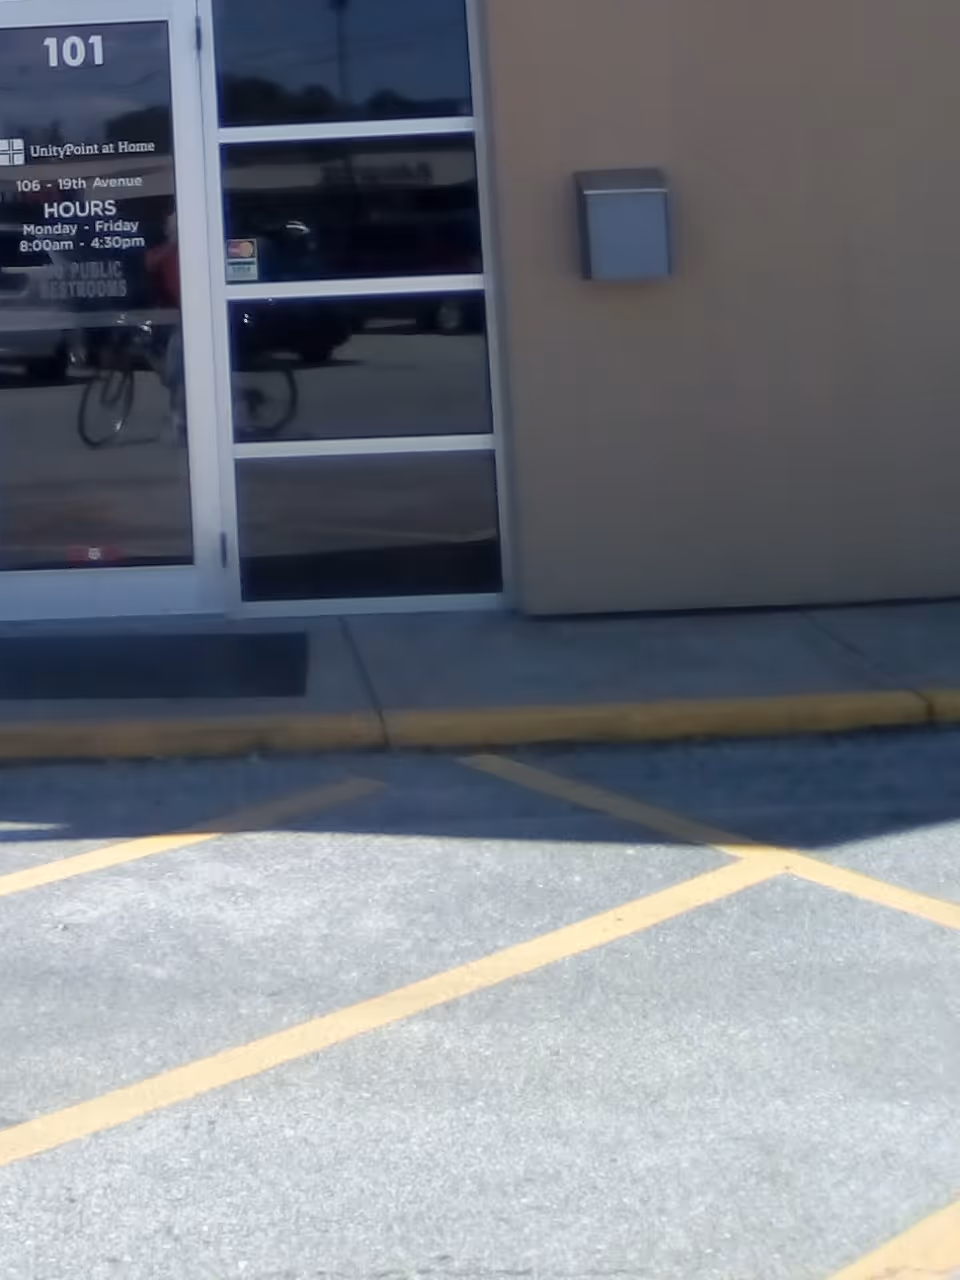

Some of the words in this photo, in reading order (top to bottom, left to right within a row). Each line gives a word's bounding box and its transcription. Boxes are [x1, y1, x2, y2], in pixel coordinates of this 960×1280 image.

[43, 34, 105, 67] 101
[29, 142, 99, 159] UnityPoint
[101, 142, 115, 154] at
[118, 140, 156, 153] Home
[16, 179, 41, 192] 106
[57, 177, 87, 191] 19th
[92, 176, 144, 189] Avenue
[43, 200, 117, 219] HOURS
[22, 222, 78, 236] Monday
[94, 220, 140, 233] Friday
[19, 239, 74, 252] 8:00am
[90, 236, 146, 250] 4:30pm
